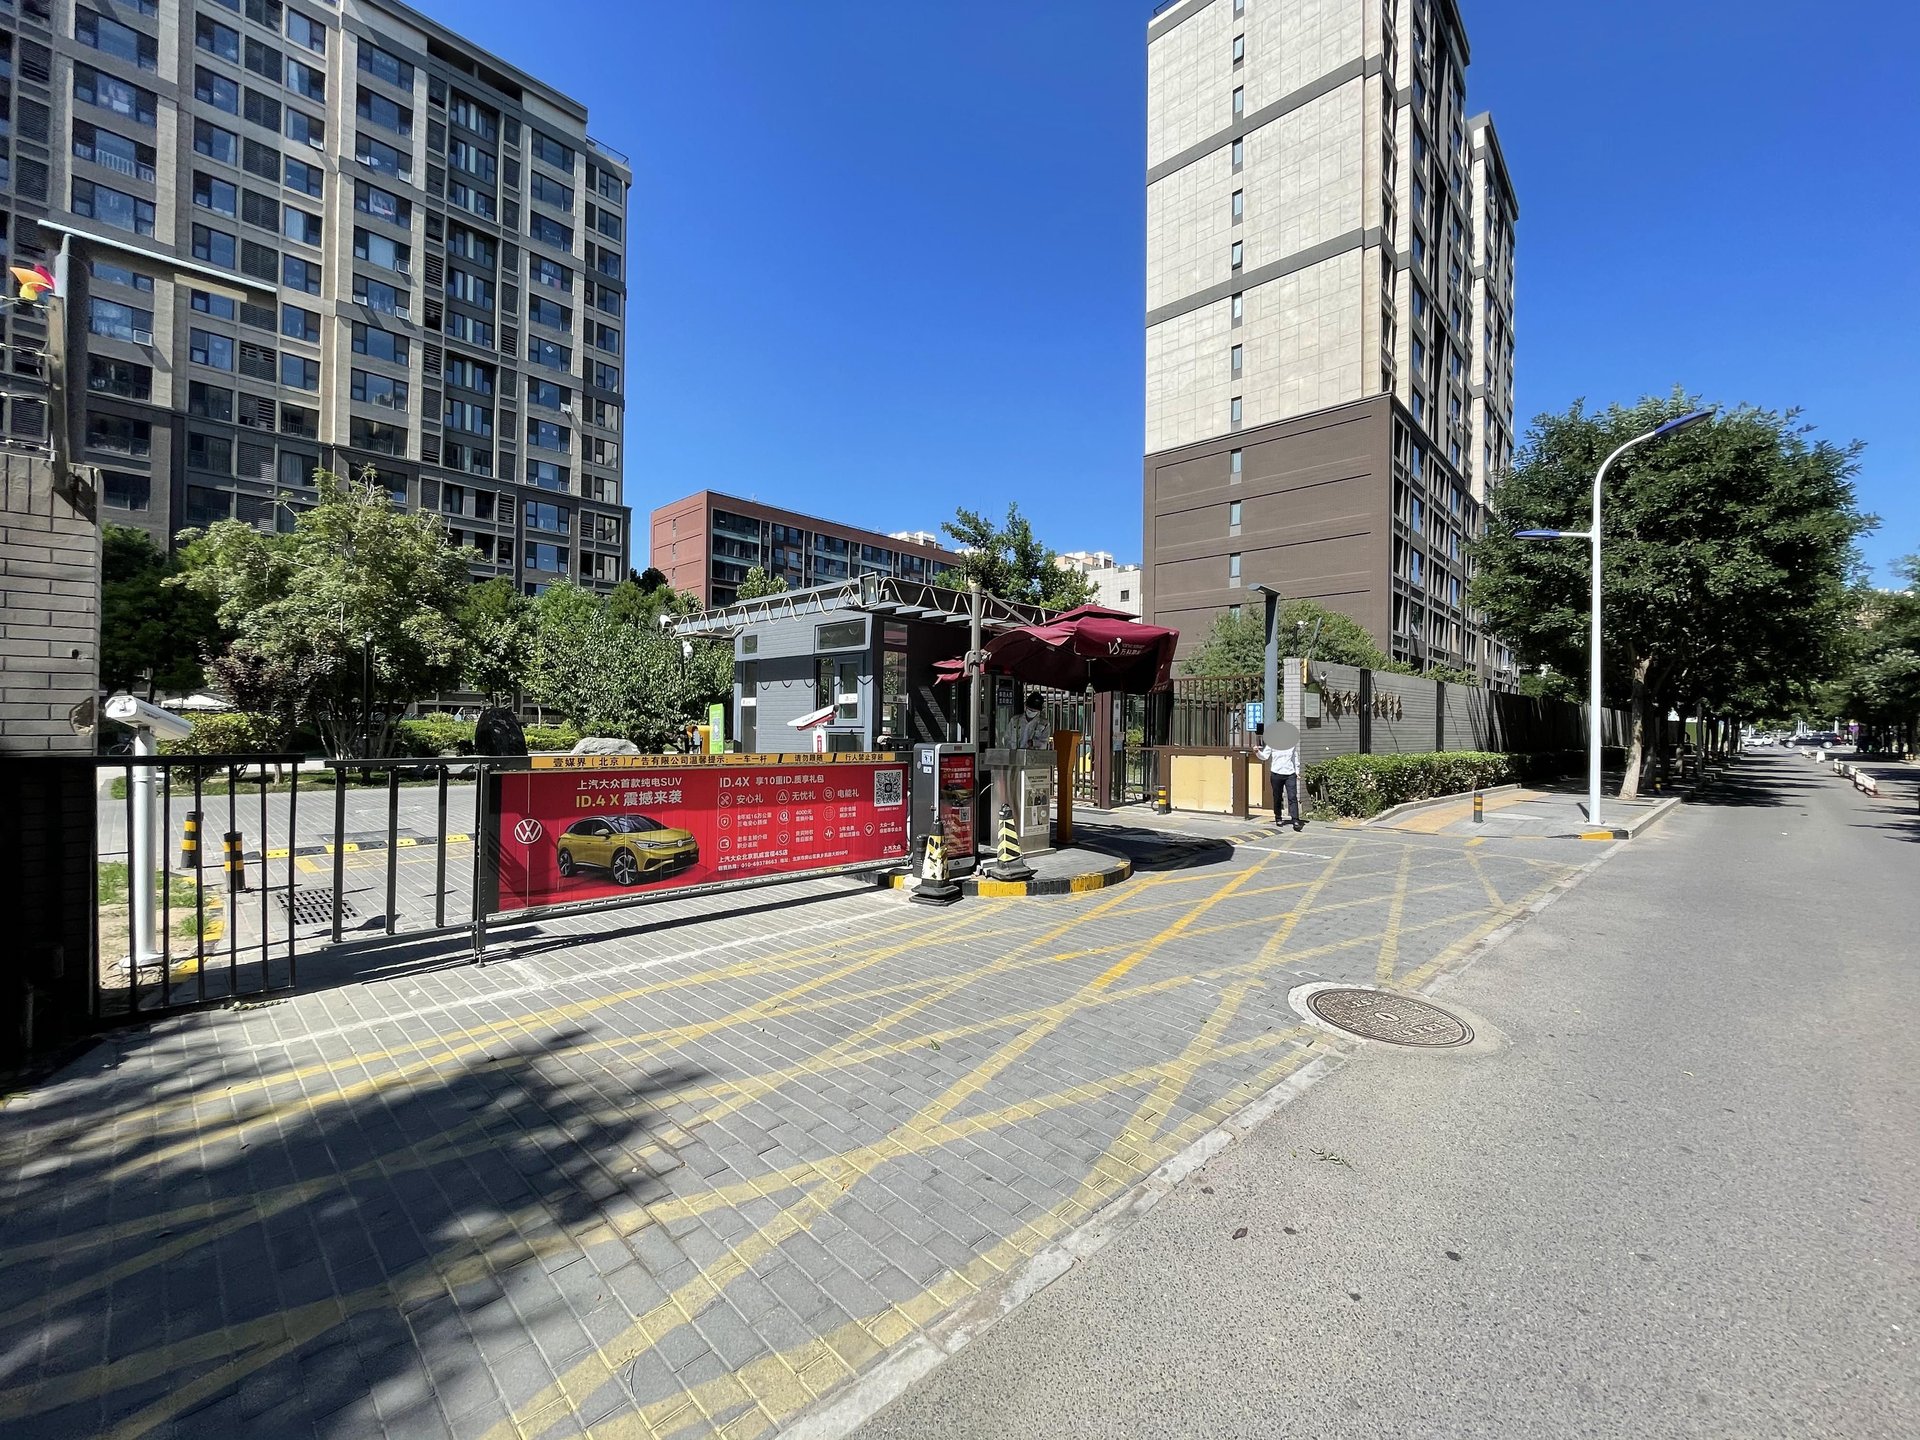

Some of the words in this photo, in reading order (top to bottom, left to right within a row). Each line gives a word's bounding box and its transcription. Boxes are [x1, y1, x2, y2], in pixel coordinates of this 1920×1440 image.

[845, 753, 884, 761] 行人禁止穿越
[577, 777, 682, 790] 上汽大众首款纯电SUV
[623, 789, 683, 807] 震撼来袭
[791, 791, 817, 801] 无忧礼
[837, 788, 860, 798] 电能礼
[736, 794, 764, 804] 安心礼
